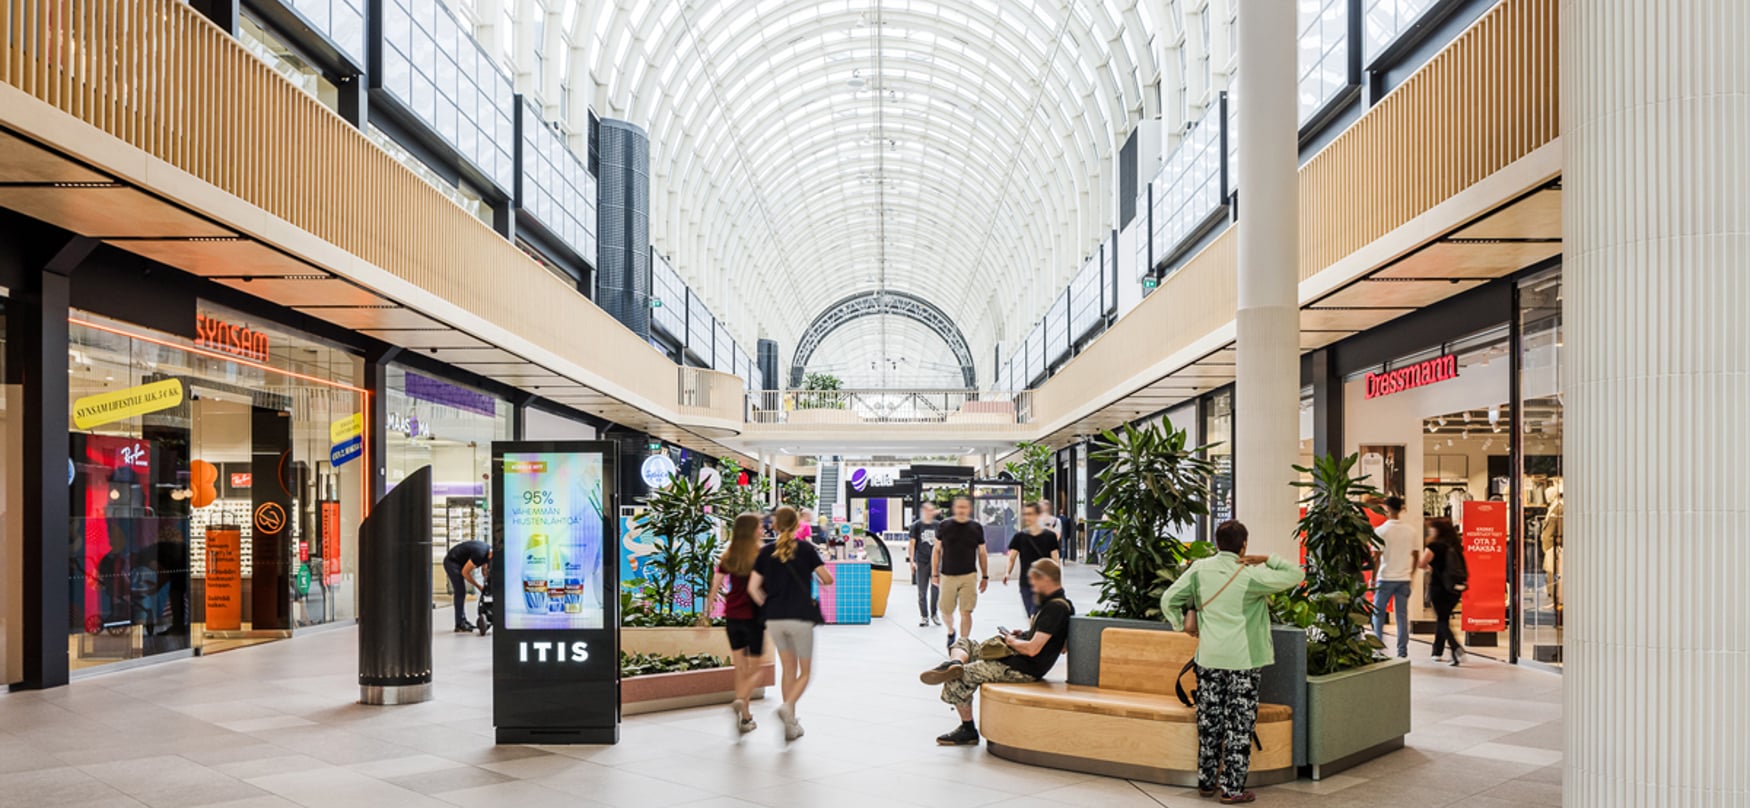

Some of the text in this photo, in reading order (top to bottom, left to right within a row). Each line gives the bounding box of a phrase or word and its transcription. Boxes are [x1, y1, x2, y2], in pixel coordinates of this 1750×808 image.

[193, 313, 269, 362] SYNSAM
[1364, 353, 1456, 400] Dressmann
[76, 403, 108, 418] SYNSAM
[108, 395, 143, 410] LIFESTYLE
[522, 490, 554, 505] 95%
[1467, 544, 1502, 553] MAKSA 2
[1473, 537, 1490, 546] OTA
[519, 641, 589, 662] ITIS
